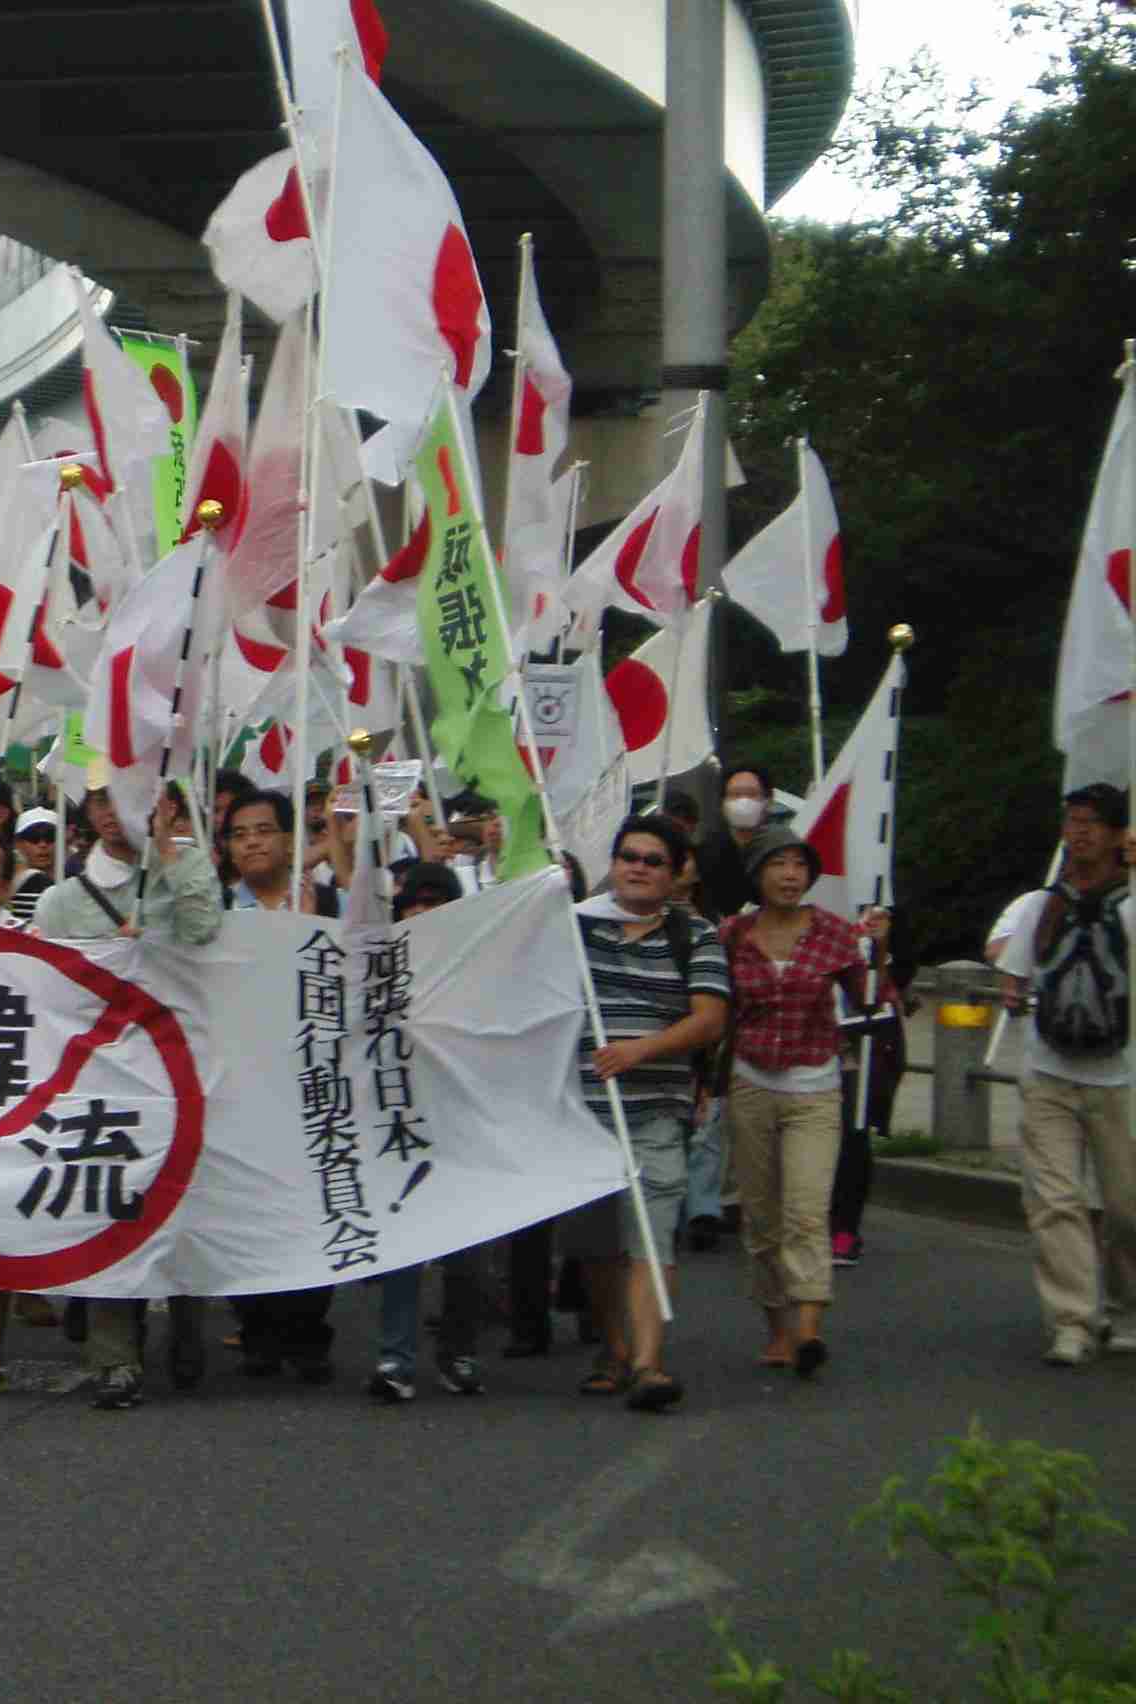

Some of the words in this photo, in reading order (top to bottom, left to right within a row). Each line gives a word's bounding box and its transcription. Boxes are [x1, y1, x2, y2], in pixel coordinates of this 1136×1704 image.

[295, 929, 380, 1273] 全国行動委員会
